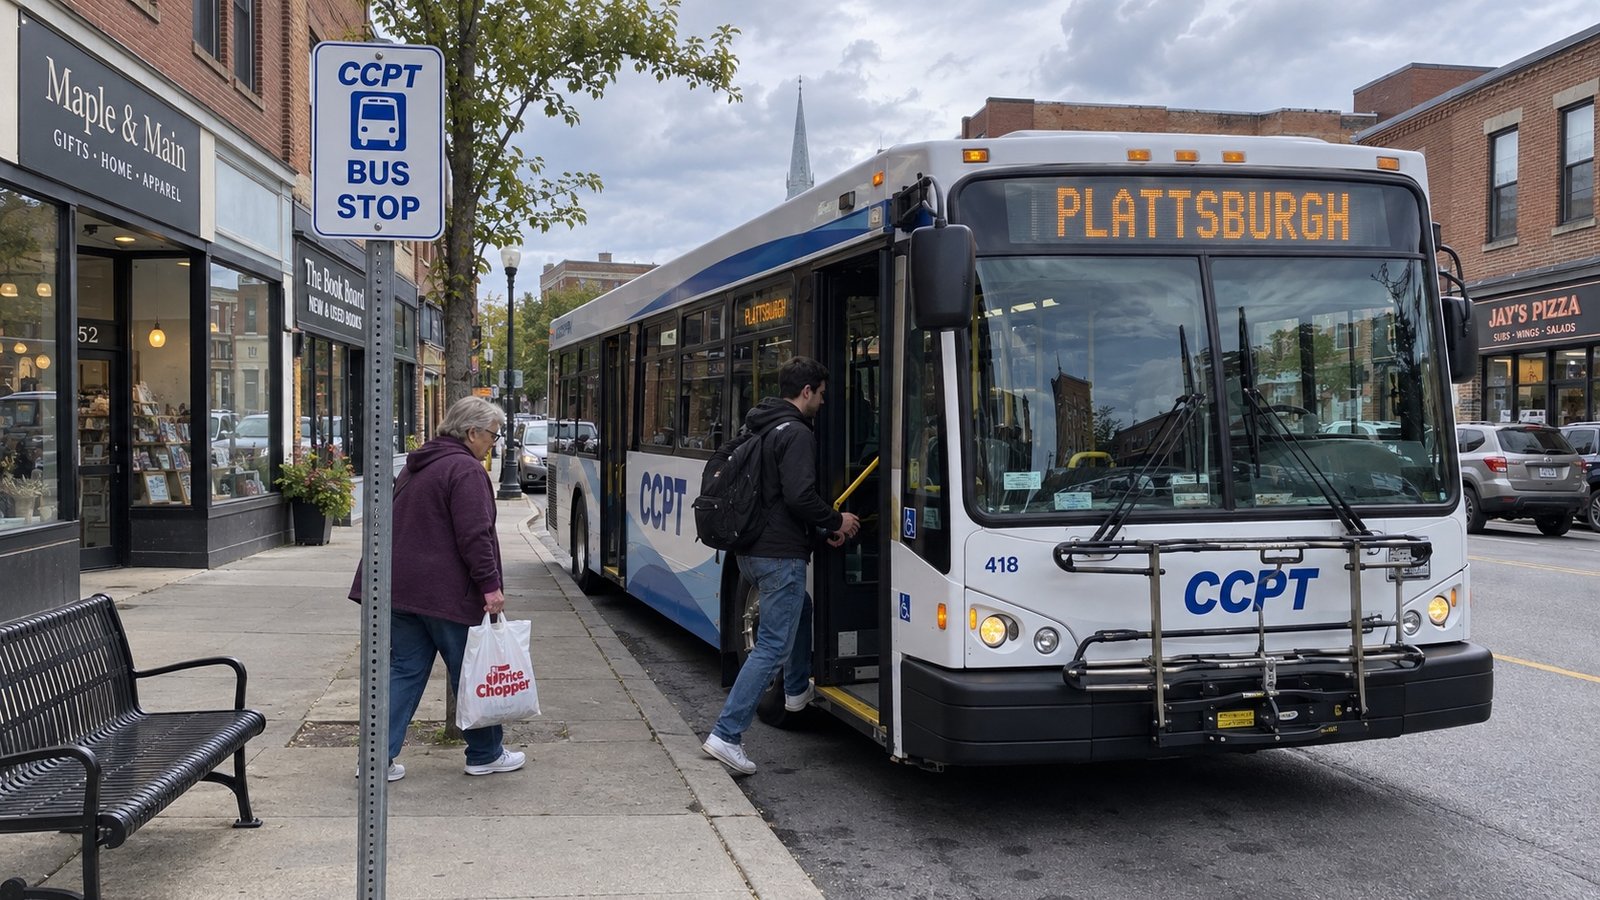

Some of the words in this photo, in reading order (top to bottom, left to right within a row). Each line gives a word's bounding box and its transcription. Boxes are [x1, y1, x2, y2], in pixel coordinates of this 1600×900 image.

[338, 61, 422, 88] CCPT
[46, 56, 116, 135] Maple
[121, 104, 138, 147] &
[143, 114, 187, 173] Main
[53, 129, 90, 160] GIFTS
[101, 151, 133, 181] HOME
[142, 173, 182, 203] APPAREL
[347, 159, 410, 186] BUS
[337, 193, 420, 221] STOP
[1057, 187, 1350, 241] PLATTSBURGH
[305, 258, 321, 290] The
[324, 267, 343, 301] Book
[308, 294, 324, 316] NEW
[330, 304, 345, 323] USED
[1488, 303, 1528, 328] JAY'S
[1532, 295, 1581, 320] PIZZA
[1493, 332, 1511, 342] SUBS
[1516, 327, 1540, 339] WINGS
[1546, 322, 1576, 335] SALADS
[639, 471, 687, 536] CCPT
[985, 556, 1019, 574] 418
[1185, 567, 1320, 615] CCPT
[476, 679, 530, 698] Chopper
[499, 670, 524, 685] Price
